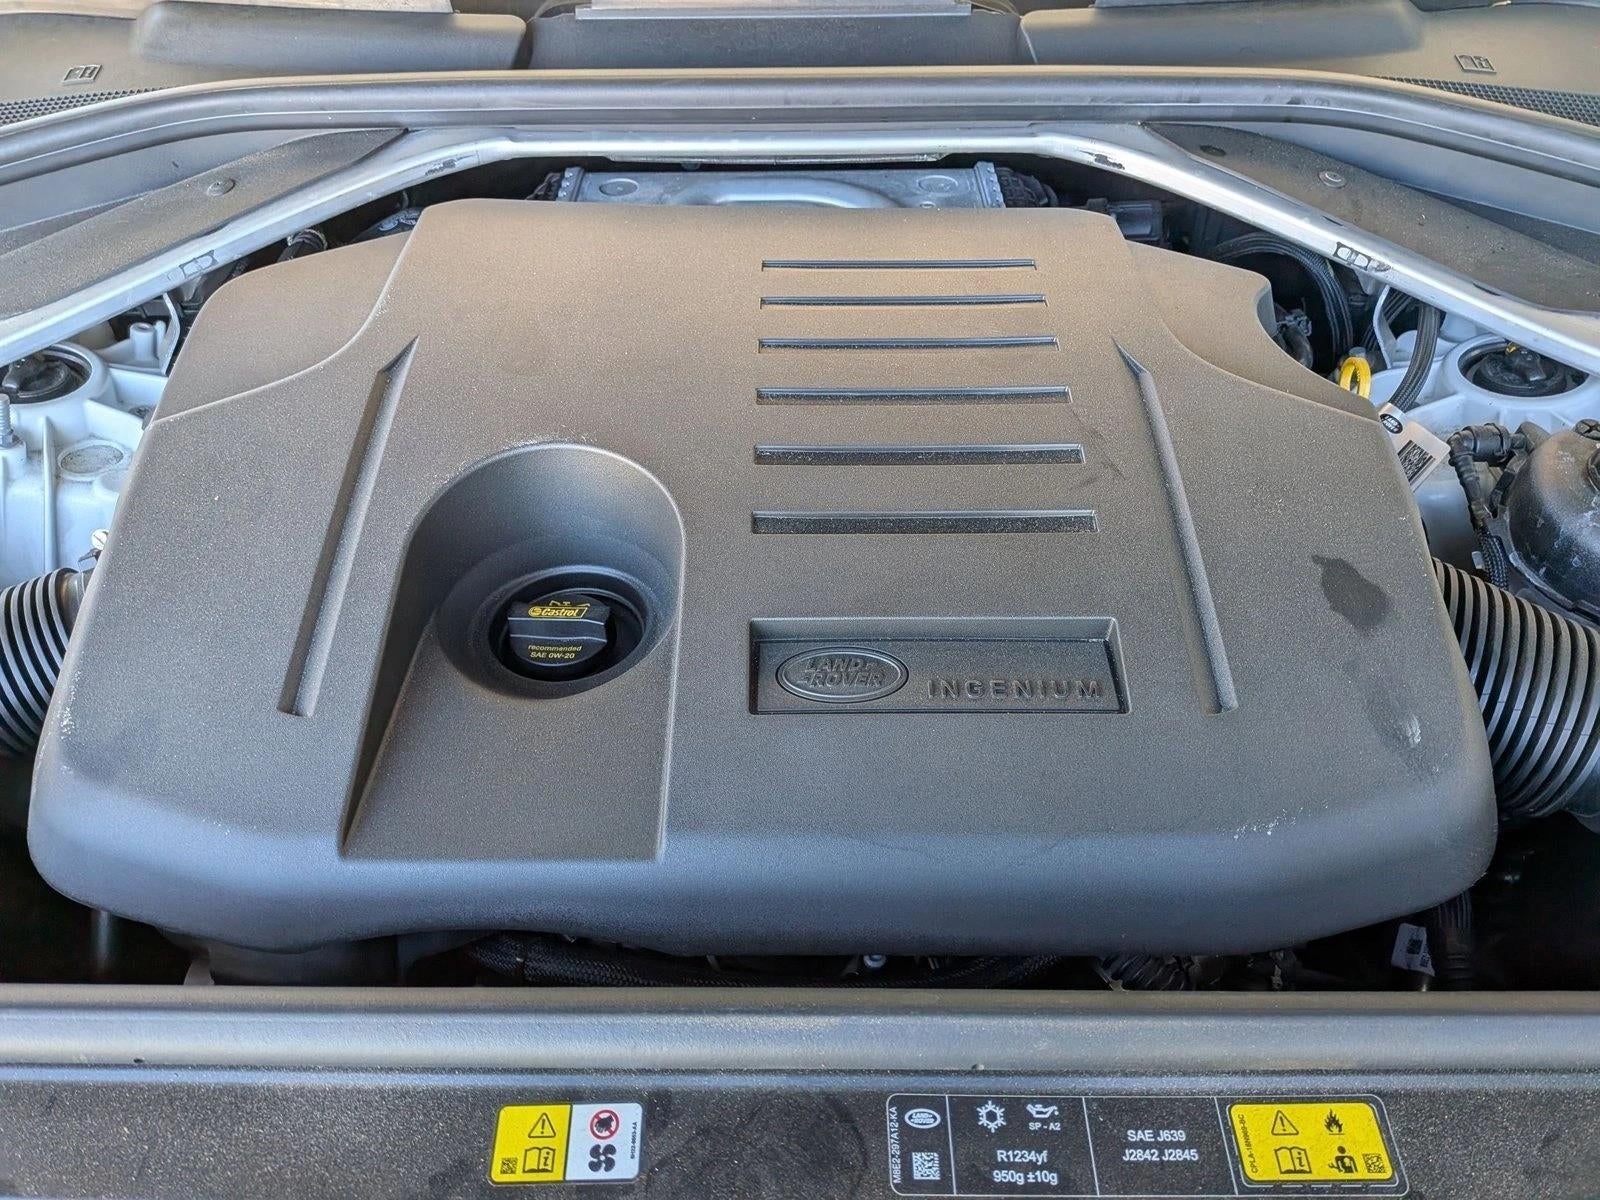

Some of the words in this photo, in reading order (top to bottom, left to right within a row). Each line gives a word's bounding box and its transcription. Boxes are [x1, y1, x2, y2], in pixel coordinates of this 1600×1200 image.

[541, 608, 579, 616] Castrol
[528, 644, 582, 652] recommended
[927, 678, 1101, 699] INGENIUM
[1127, 1130, 1154, 1141] SAE
[1157, 1130, 1186, 1141] J639
[997, 1149, 1048, 1165] R1234yf
[1123, 1149, 1159, 1161] J2842
[1162, 1149, 1198, 1161] J2845
[993, 1171, 1024, 1185] 950g
[1027, 1171, 1058, 1185] ±10g
